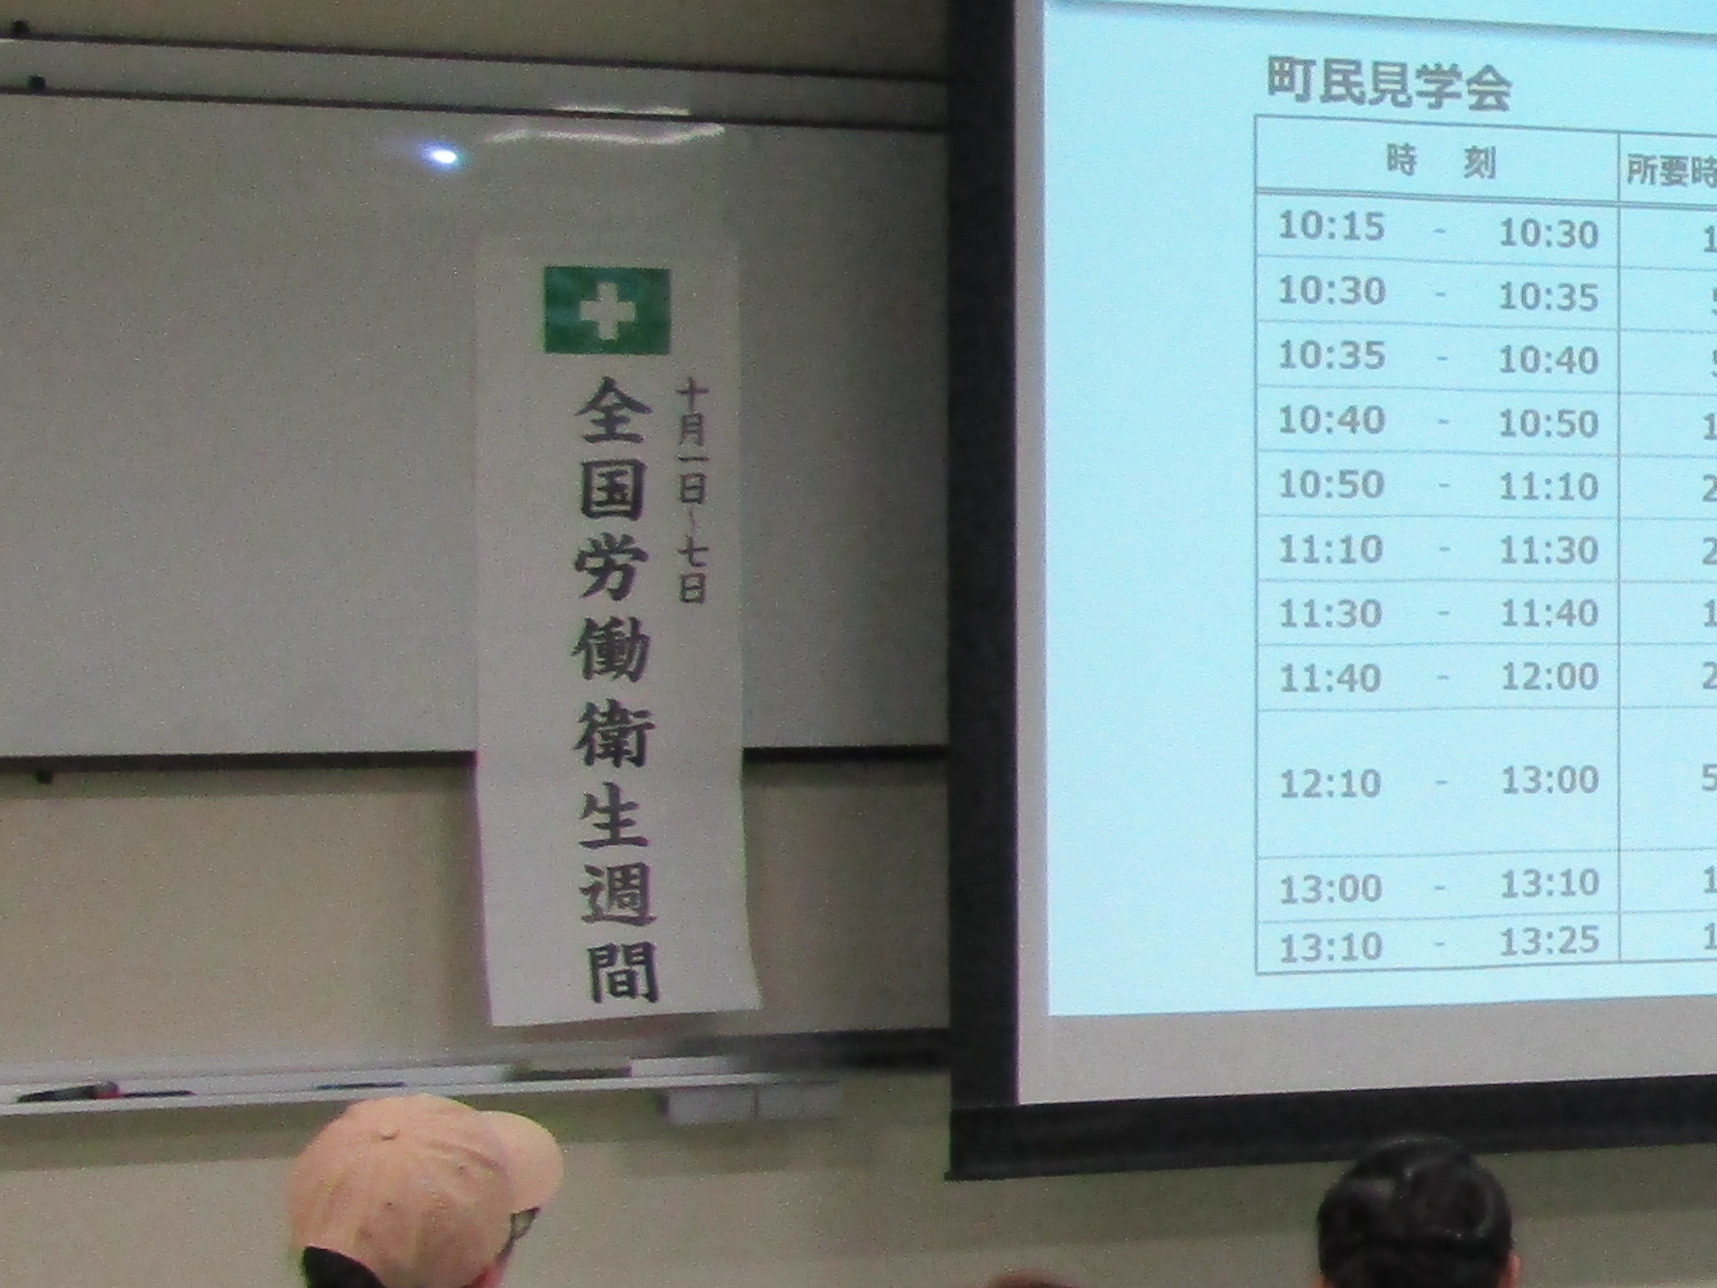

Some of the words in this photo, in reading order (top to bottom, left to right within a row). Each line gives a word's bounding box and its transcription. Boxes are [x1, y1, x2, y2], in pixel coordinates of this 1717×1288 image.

[1266, 54, 1512, 112] 町民見学会
[1278, 208, 1386, 240] 10:15
[1498, 216, 1600, 250] 10:30
[1278, 274, 1386, 306] 10:30
[1498, 280, 1600, 312] 10:35
[1278, 338, 1386, 370] 10:35
[1498, 344, 1600, 376] 10:40
[1278, 402, 1386, 434] 10:40
[1498, 408, 1600, 438] 10:50
[1278, 468, 1386, 500] 10:50
[1498, 470, 1600, 502] 11:10
[1278, 532, 1384, 564] 11:10
[1498, 534, 1600, 566] 11:30
[1278, 598, 1384, 630] 11:30
[1498, 596, 1600, 628] 11:40
[571, 374, 661, 1005] 全国労働衛生週間
[1278, 662, 1384, 694] 11:40
[1498, 660, 1600, 692] 12:00
[1278, 766, 1384, 800] 12:10
[1498, 764, 1600, 794] 13:00
[1278, 872, 1384, 904] 13:00
[1498, 866, 1600, 898] 13:10
[1278, 930, 1384, 964] 13:10
[1498, 924, 1600, 958] 13:25
